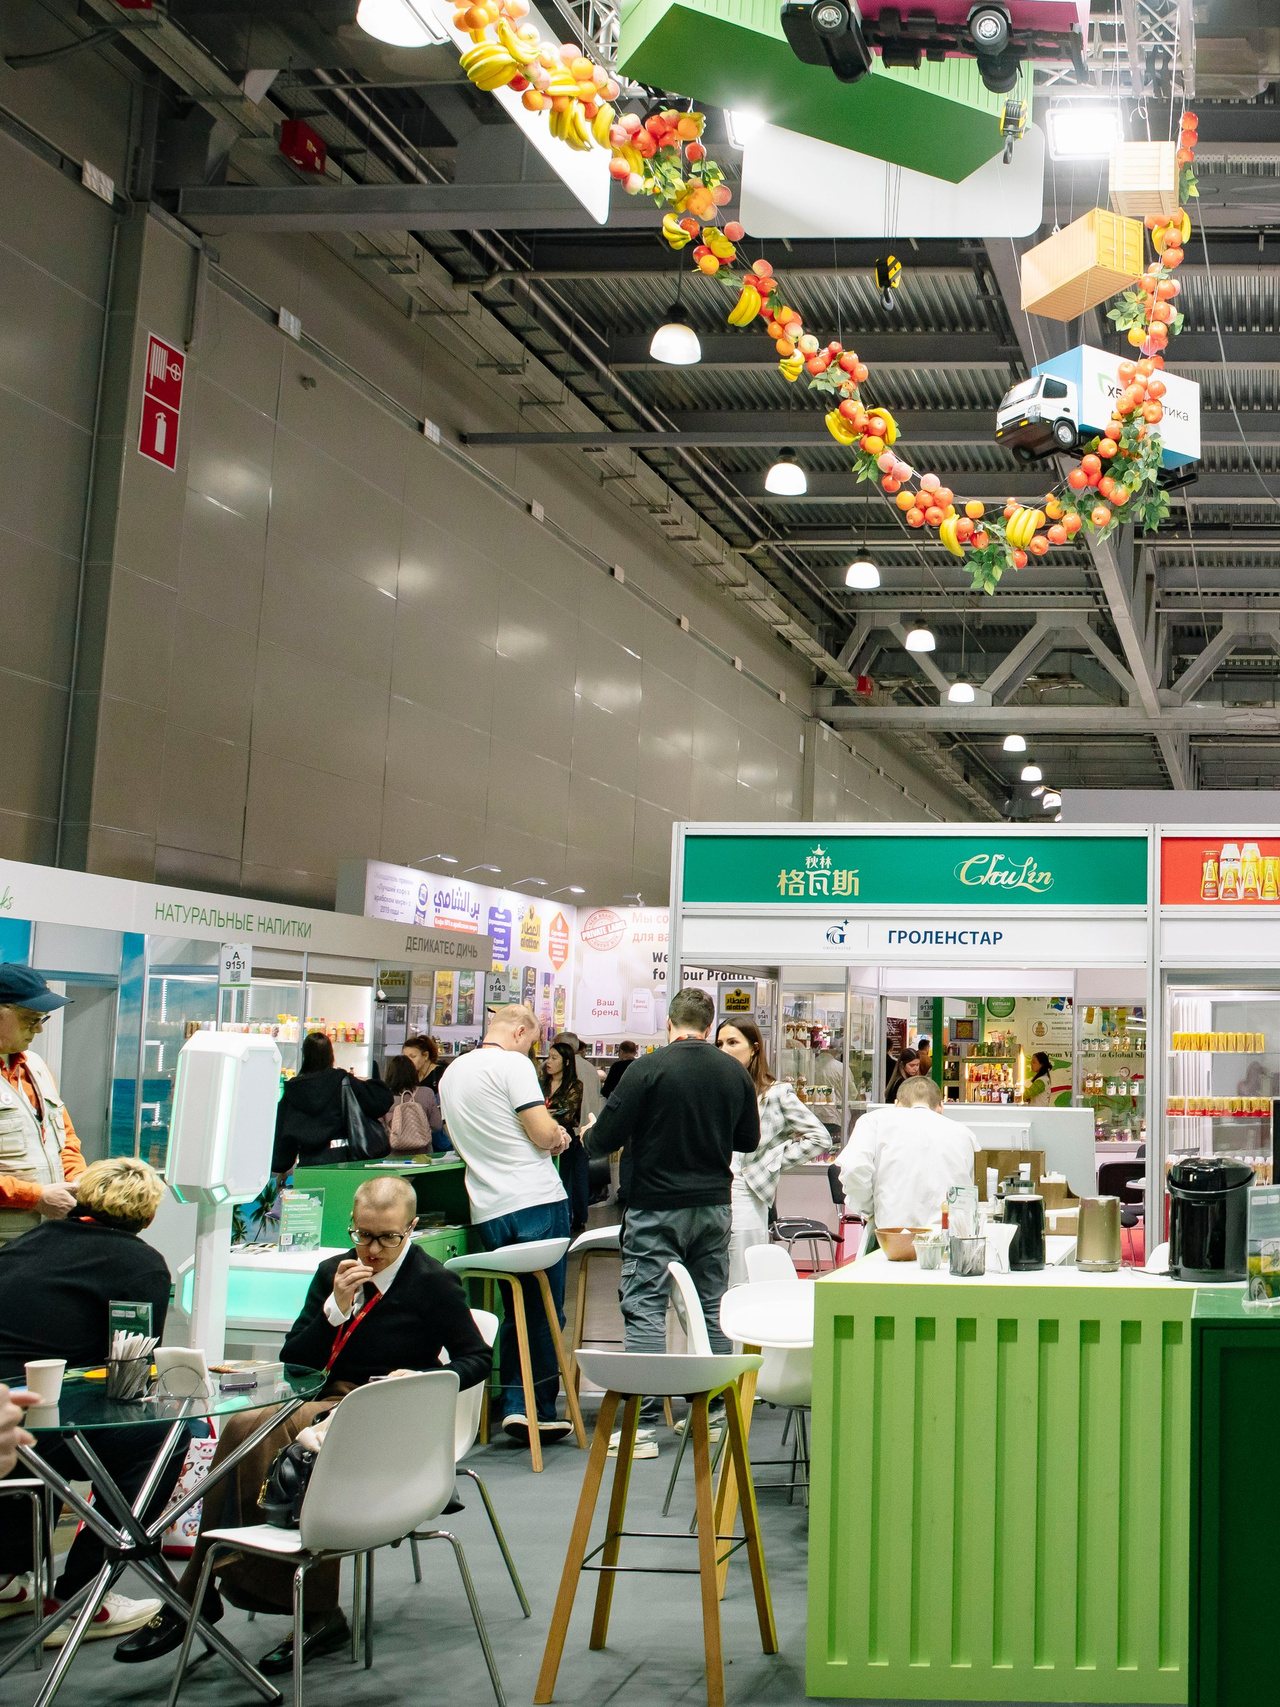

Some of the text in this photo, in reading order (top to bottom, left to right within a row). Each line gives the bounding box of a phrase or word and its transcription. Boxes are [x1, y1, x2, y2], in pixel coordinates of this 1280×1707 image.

[805, 855, 833, 869] 秋林
[776, 869, 860, 897] 格瓦斯
[155, 901, 312, 939] НАТУРАЛЬНЫЕ НАПИТКИ
[632, 912, 669, 924] Мы со
[632, 932, 654, 944] для
[658, 932, 669, 942] ва
[888, 930, 1004, 945] ГРОЛЕНСТАР
[405, 935, 478, 959] ДЕЛИКАТЕС ДИЧЬ
[232, 951, 240, 960] A
[225, 960, 246, 970] 9151
[652, 968, 666, 980] fo
[683, 971, 704, 981] our
[489, 984, 506, 992] 9143
[596, 998, 615, 1006] Ваш
[591, 1008, 619, 1017] бренд
